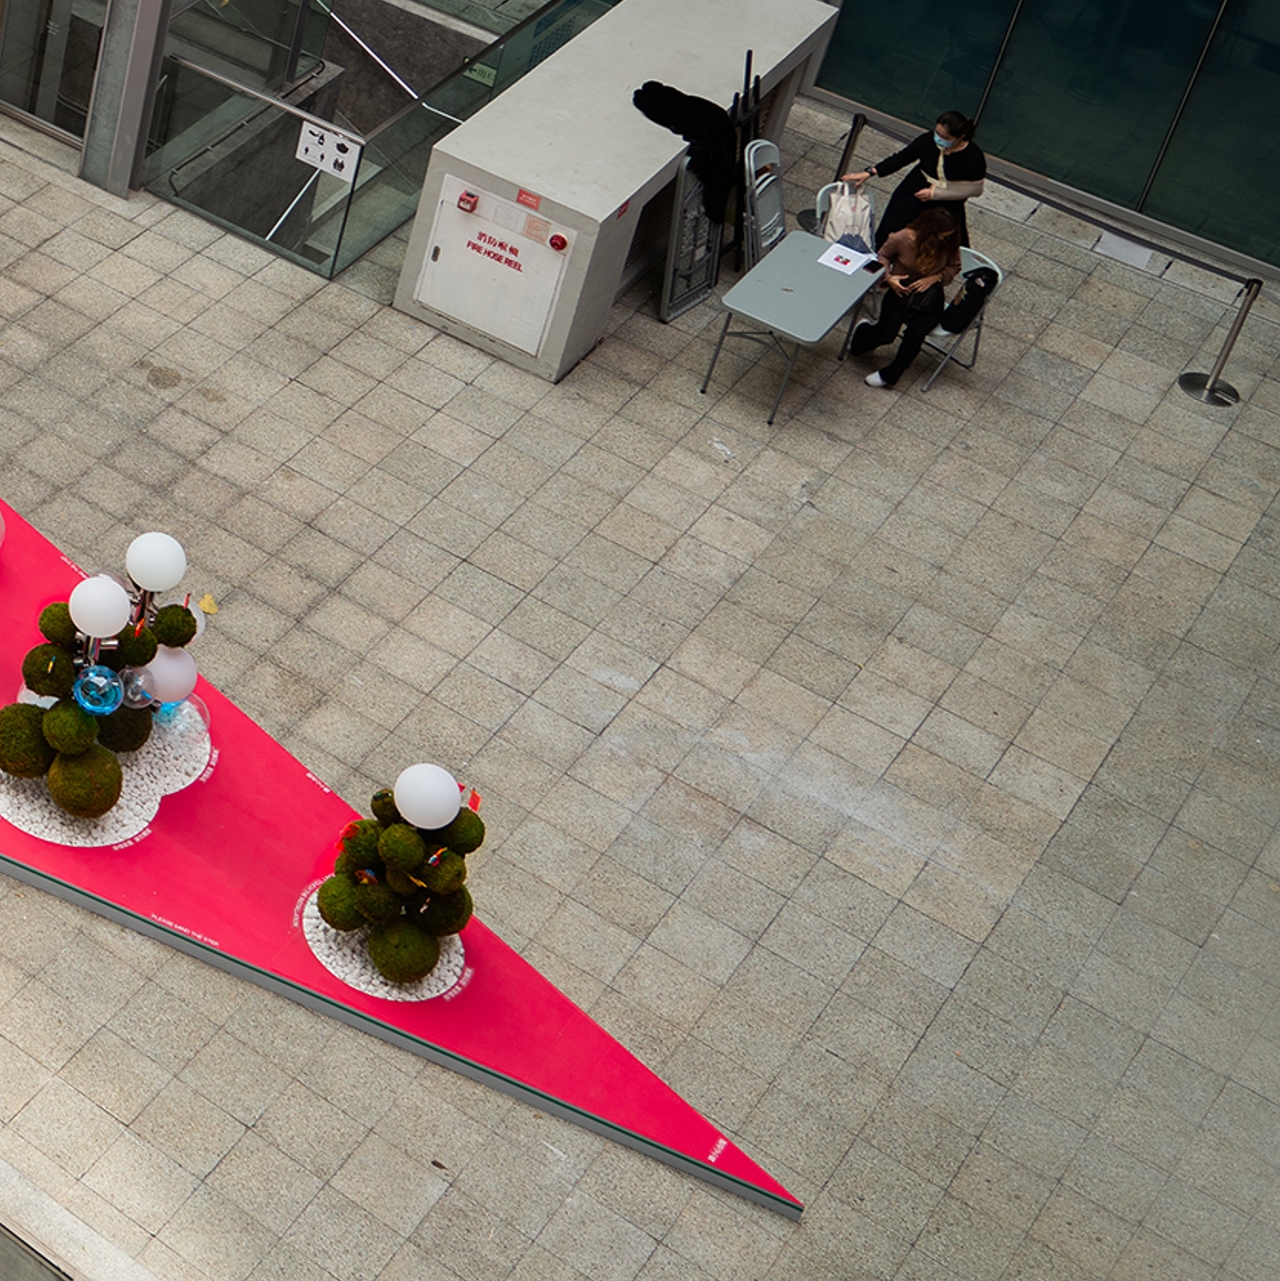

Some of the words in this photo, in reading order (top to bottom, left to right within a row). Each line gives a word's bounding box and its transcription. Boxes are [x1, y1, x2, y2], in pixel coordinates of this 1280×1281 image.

[466, 240, 483, 255] FIRE
[483, 248, 504, 264] HOSE
[503, 257, 523, 273] REEL
[151, 913, 174, 927] PLEASE
